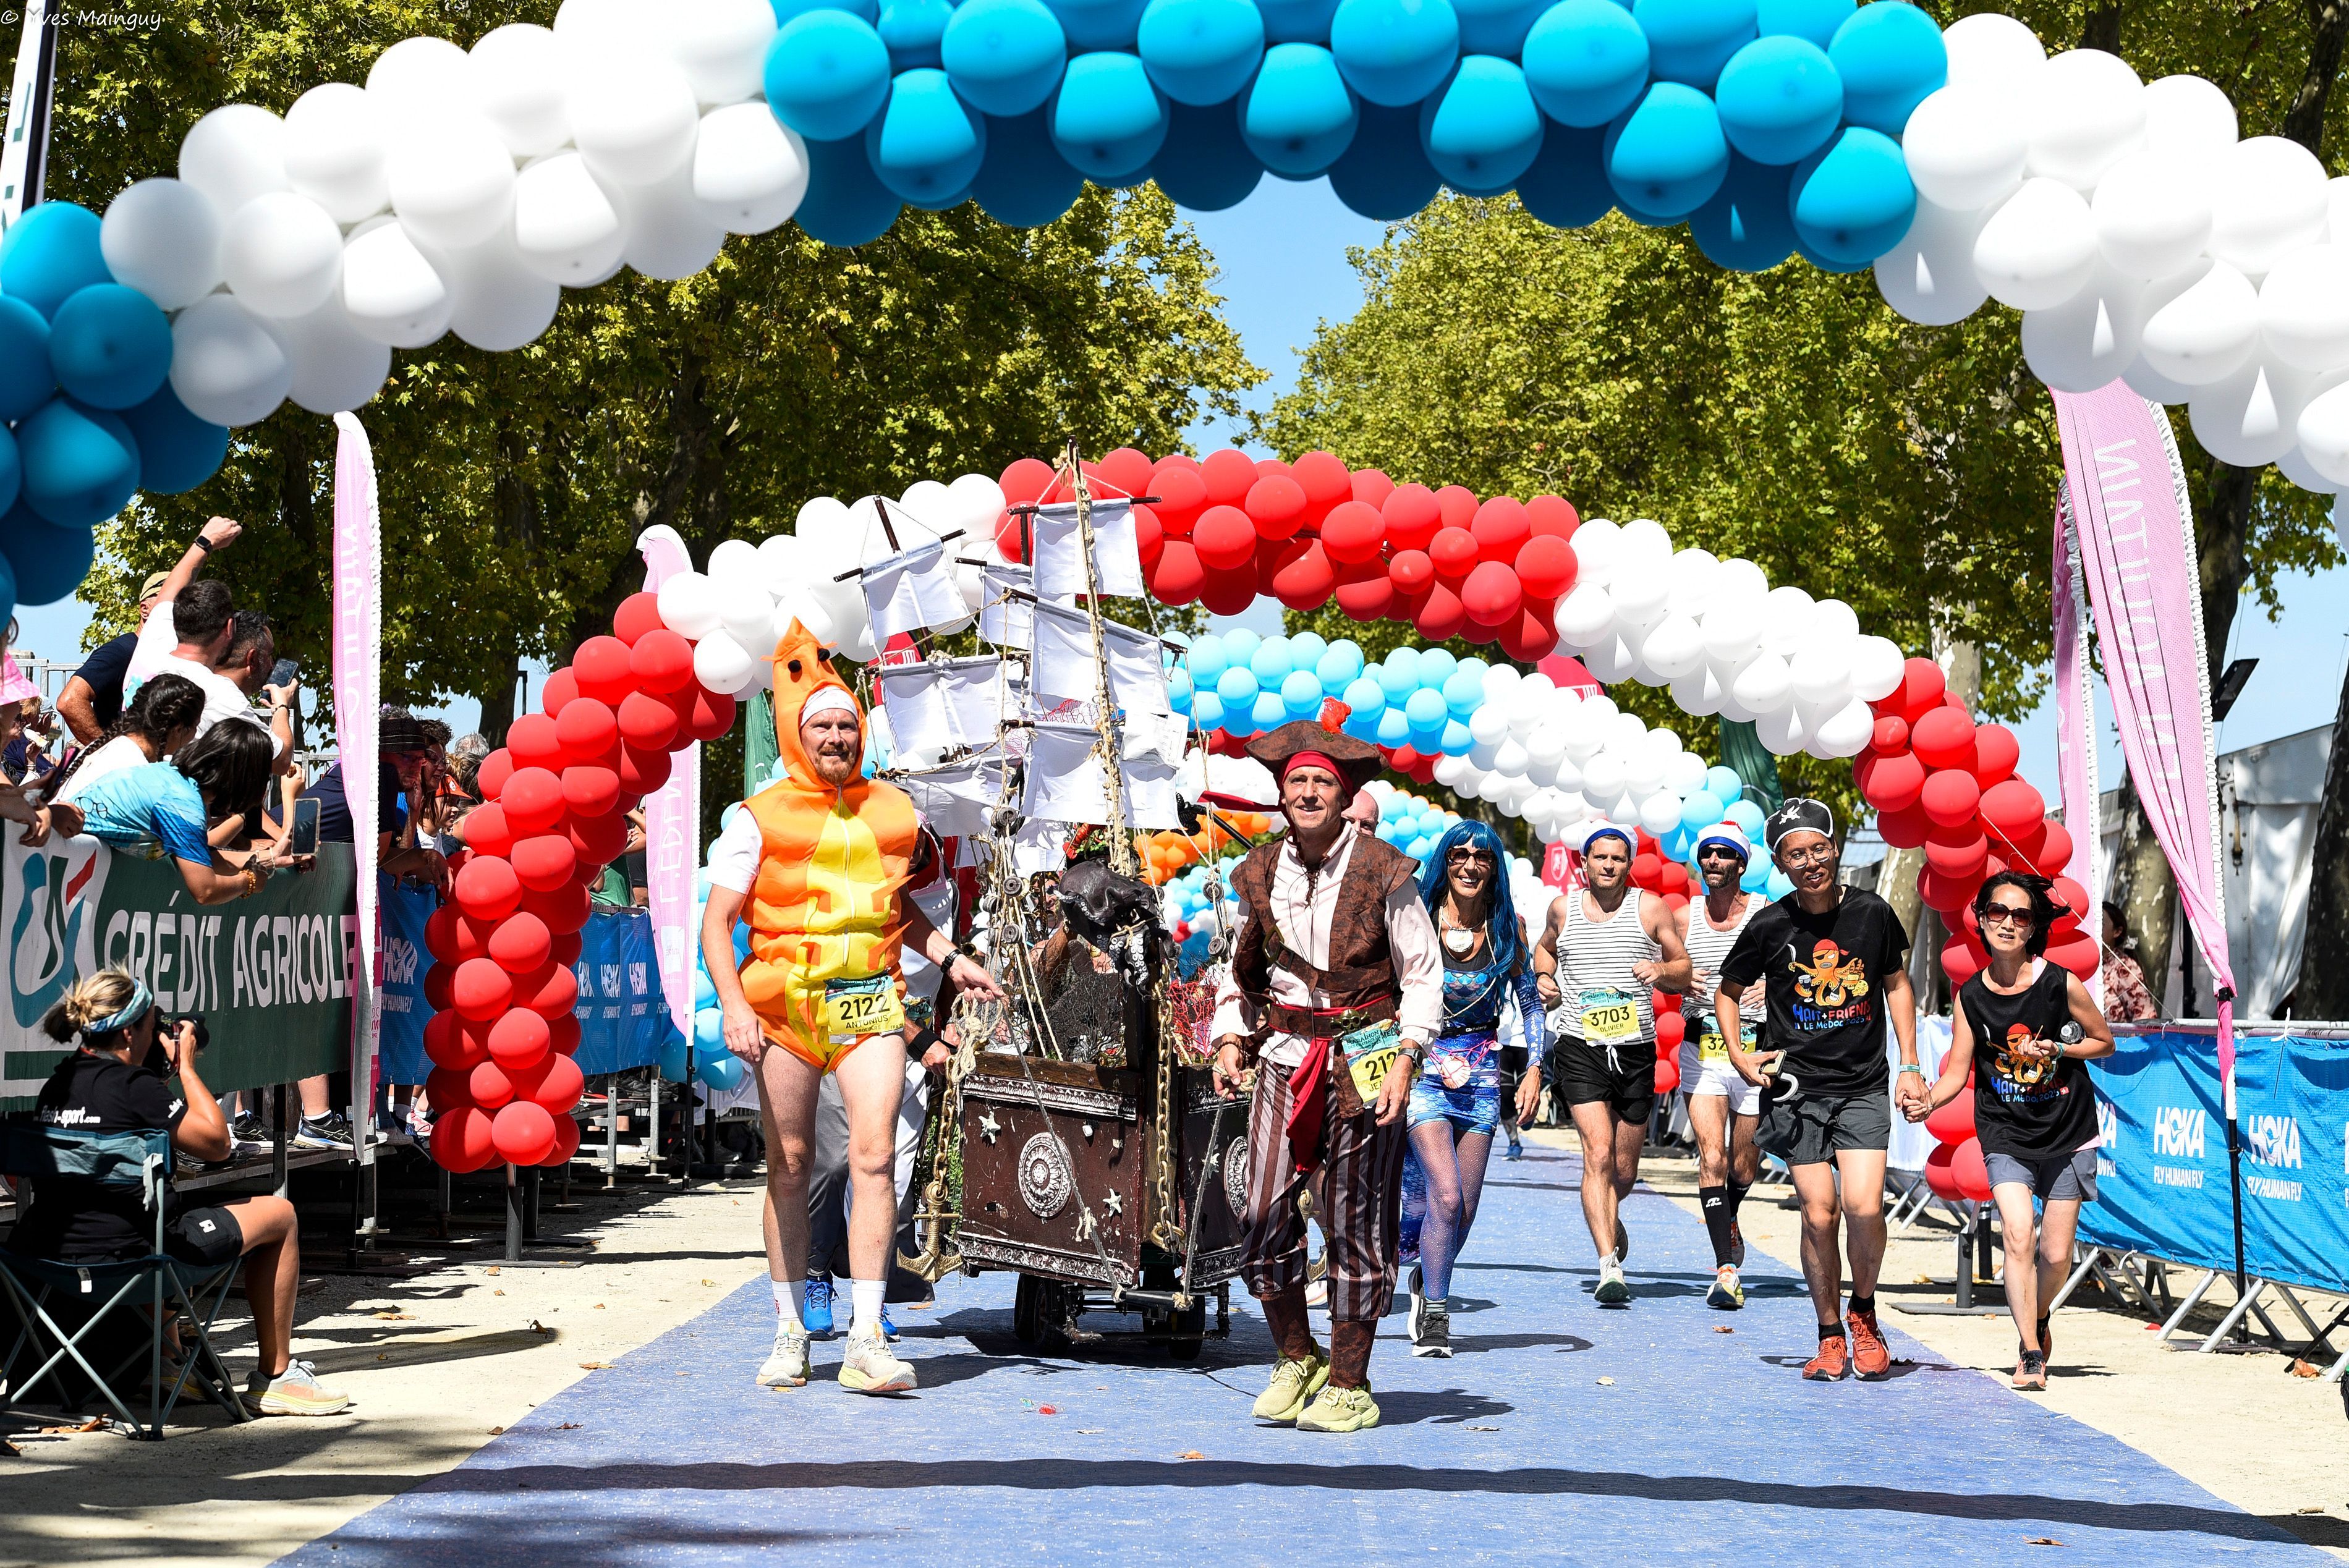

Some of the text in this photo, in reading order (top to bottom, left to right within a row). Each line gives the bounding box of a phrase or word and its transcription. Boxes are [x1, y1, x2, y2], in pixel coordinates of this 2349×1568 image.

[104, 890, 357, 1013] CRÉDIT AGRICOLE
[382, 935, 418, 985] HOKA
[839, 994, 890, 1020] 2122
[1589, 1006, 1629, 1027] 3703
[1793, 1003, 1821, 1022] HAIT
[845, 1014, 889, 1029] ANTONIUS
[1600, 1023, 1625, 1033] OLIVIER
[1804, 1022, 1814, 1030] LE
[1845, 1017, 1865, 1025] 2025
[1365, 1048, 1400, 1082] 212
[1990, 1076, 2020, 1094] HAIT
[2001, 1095, 2011, 1103] LE
[2153, 1106, 2206, 1158] HOKA
[2248, 1114, 2303, 1169] HOKA
[2153, 1165, 2204, 1189] FLY HUMAN FLY
[2246, 1176, 2303, 1203] FLY HUMAN FLY
